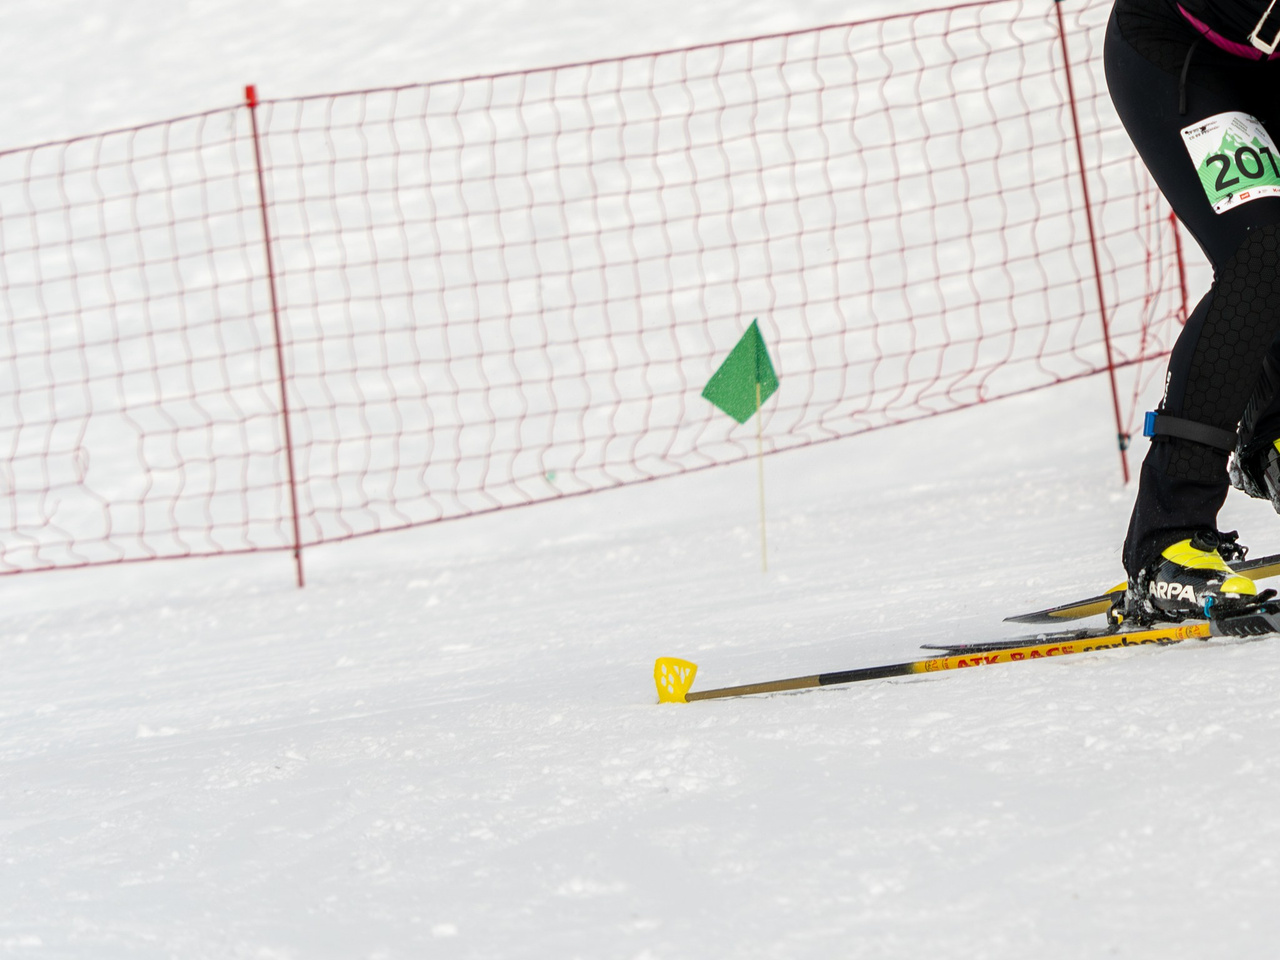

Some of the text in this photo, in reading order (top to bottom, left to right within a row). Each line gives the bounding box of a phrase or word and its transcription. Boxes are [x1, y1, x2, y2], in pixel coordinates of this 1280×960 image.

[1206, 146, 1280, 192] 201
[1148, 580, 1197, 603] ARPA
[957, 655, 1000, 668] ATK
